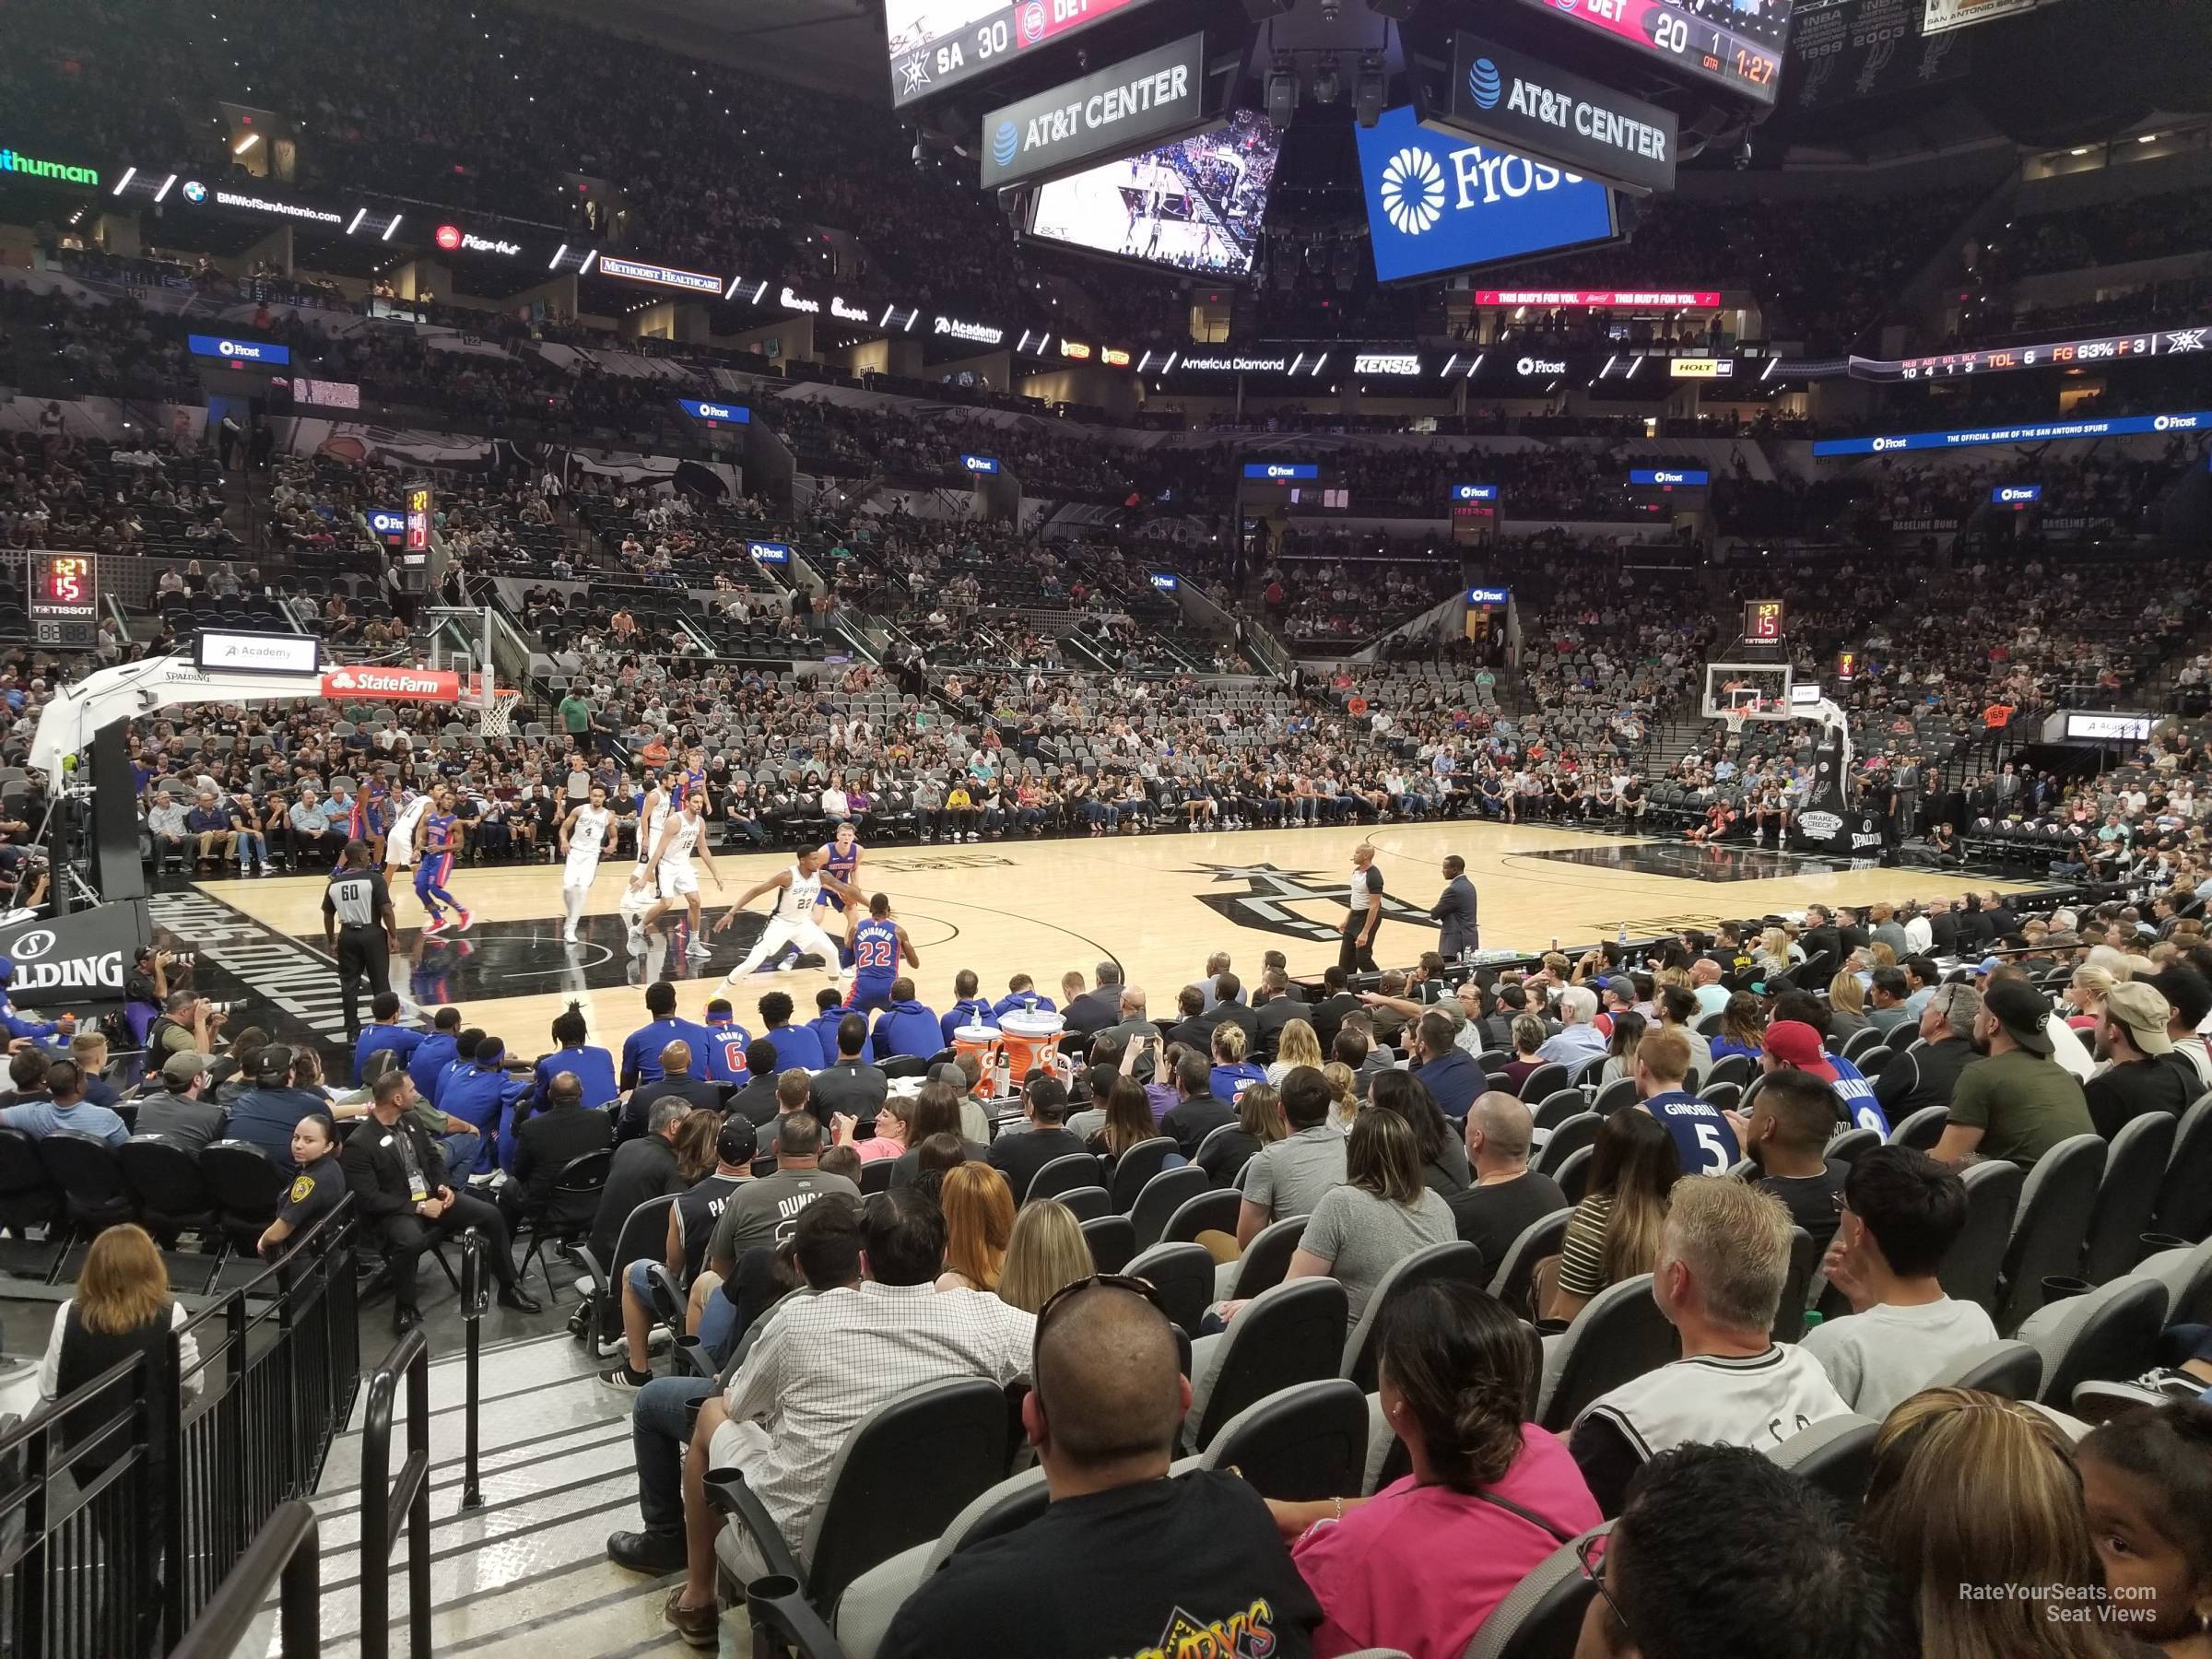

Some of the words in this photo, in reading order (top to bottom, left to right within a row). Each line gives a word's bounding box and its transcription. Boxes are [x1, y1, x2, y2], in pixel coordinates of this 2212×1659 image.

[1587, 0, 1627, 23] DET
[1809, 9, 1842, 27] NBA
[1927, 17, 1947, 26] SAN
[1949, 3, 1994, 20] ANTONIO
[977, 19, 1007, 59] 30
[1654, 13, 1688, 53] 20
[1712, 33, 1720, 54] 1
[1800, 41, 1843, 61] 1999
[936, 41, 964, 75] SA
[1703, 55, 1720, 72] QTR
[1736, 50, 1774, 85] 1:27
[1023, 101, 1082, 152] AT&T
[1085, 65, 1188, 129] CENTER
[1507, 77, 1572, 128] AT&T
[1574, 101, 1666, 161] CENTER
[1449, 146, 1583, 211] Fros
[217, 192, 341, 223] BMWofSanAntonio.com
[461, 233, 496, 251] Pizza
[496, 240, 522, 255] Hut
[604, 260, 660, 280] METHODIST
[661, 270, 719, 290] HEALTHCARE
[1498, 293, 1517, 303] THIS
[1517, 293, 1542, 303] BUD'S
[1543, 293, 1559, 303] FOR
[1559, 293, 1579, 303] YOU.
[1615, 293, 1634, 304] THIS
[1634, 293, 1659, 304] BUD'S
[1660, 294, 1676, 304] FOR
[1677, 294, 1696, 304] YOU.
[951, 319, 1003, 342] Academy
[234, 344, 260, 357] Frost
[2053, 347, 2074, 361] FG
[2077, 342, 2113, 359] 63%
[2119, 342, 2129, 355] F
[2133, 339, 2146, 353] 3
[1181, 358, 1231, 370] Americus
[1232, 358, 1285, 370] Diamond
[1901, 359, 1917, 368] REB
[1923, 358, 1936, 366] AST
[1987, 353, 2015, 368] TOL
[2023, 350, 2035, 364] 6
[1535, 360, 1566, 374] Frost
[1678, 363, 1713, 371] HOLT
[1901, 368, 1916, 379] 10
[1924, 366, 1934, 377] 4
[1947, 364, 1953, 374] 1
[1964, 362, 1973, 373] 3
[710, 406, 728, 418] Frost
[2169, 416, 2196, 428] Frost
[1947, 435, 1959, 443] THE
[1960, 432, 1990, 442] OFFICIAL
[1992, 431, 2009, 441] BANK
[2010, 430, 2020, 439] OF
[2021, 429, 2035, 438] THE
[2036, 429, 2051, 437] SAN
[2052, 426, 2083, 436] ANTONIO
[2084, 424, 2108, 434] SPURS
[1885, 437, 1906, 449] Frost
[976, 460, 991, 470] Frost
[1277, 467, 1294, 476] Frost
[1665, 472, 1682, 482] Frost
[1471, 488, 1489, 497] Frost
[2013, 490, 2032, 499] Frost
[1892, 520, 1933, 531] BASELINE
[763, 547, 783, 559] Frost
[56, 576, 79, 601] 15
[1159, 577, 1173, 587] Frost
[1483, 592, 1502, 600] Frost
[50, 606, 95, 615] TISSOT
[1759, 604, 1779, 616] 1:27
[1759, 616, 1774, 634] 15
[241, 646, 291, 660] Academy
[165, 671, 210, 683] SPALDING
[1989, 710, 2004, 719] 169
[1806, 820, 1832, 829] CHECK
[1807, 814, 1833, 822] BRAKE
[584, 827, 592, 836] 4
[1851, 831, 1882, 851] SPALDIN
[341, 884, 359, 901] 60
[793, 887, 819, 897] SPURS
[857, 941, 891, 969] 22
[715, 1031, 744, 1041] BROWN
[724, 1041, 747, 1073] 6
[982, 1052, 994, 1069] G
[1040, 1044, 1053, 1063] G
[1665, 1103, 1720, 1117] GINOBILI
[1694, 1123, 1729, 1176] 5
